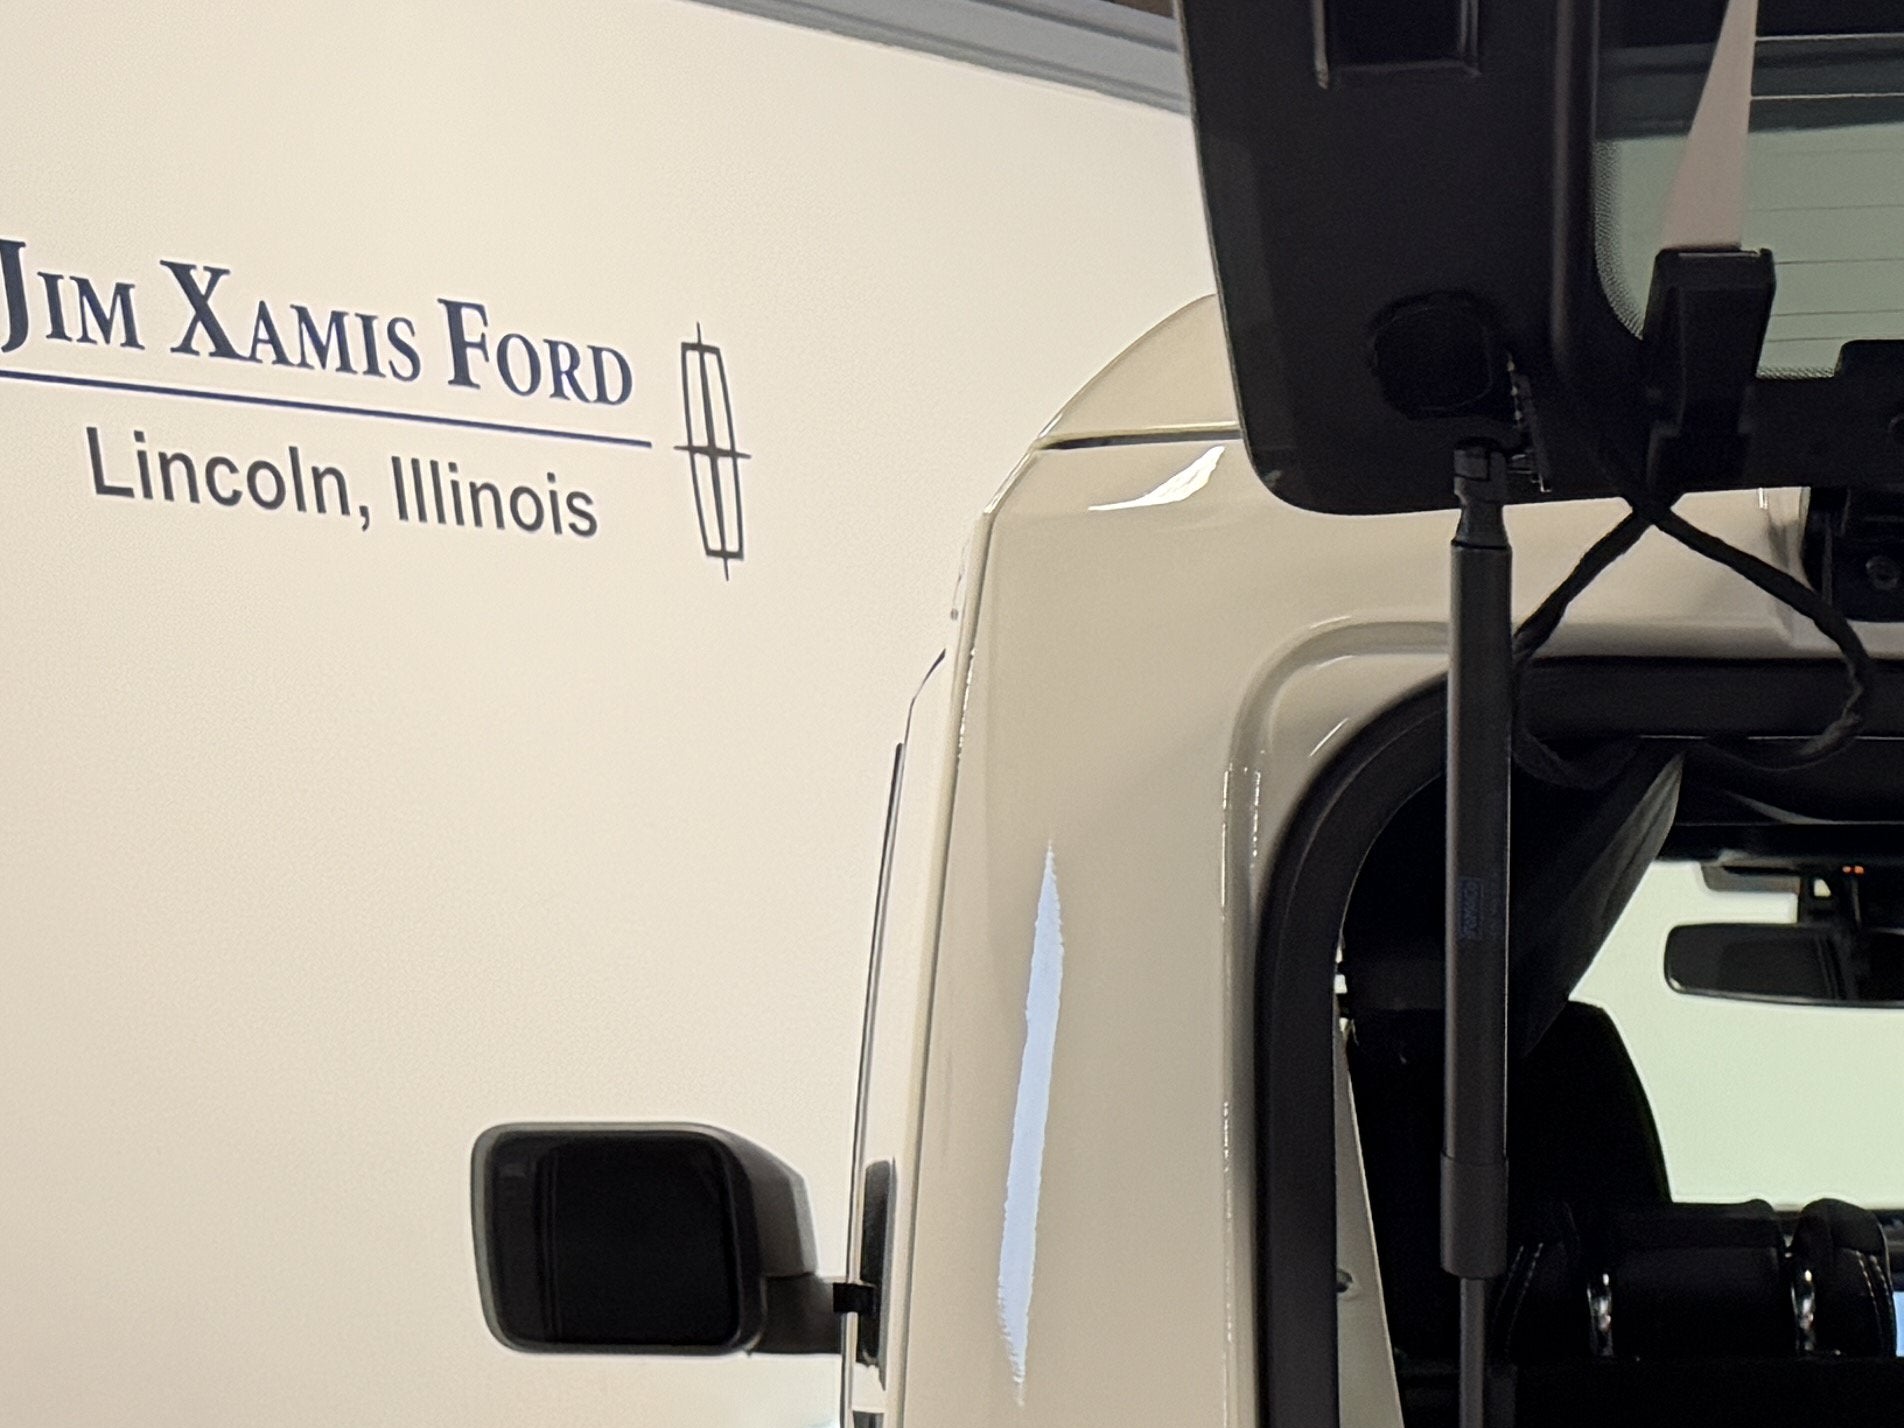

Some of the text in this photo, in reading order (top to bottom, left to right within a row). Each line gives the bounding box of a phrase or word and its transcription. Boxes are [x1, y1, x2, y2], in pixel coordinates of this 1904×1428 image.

[0, 238, 634, 406] JIM XAMIS FORD
[85, 426, 599, 538] Lincoln, Illinois
